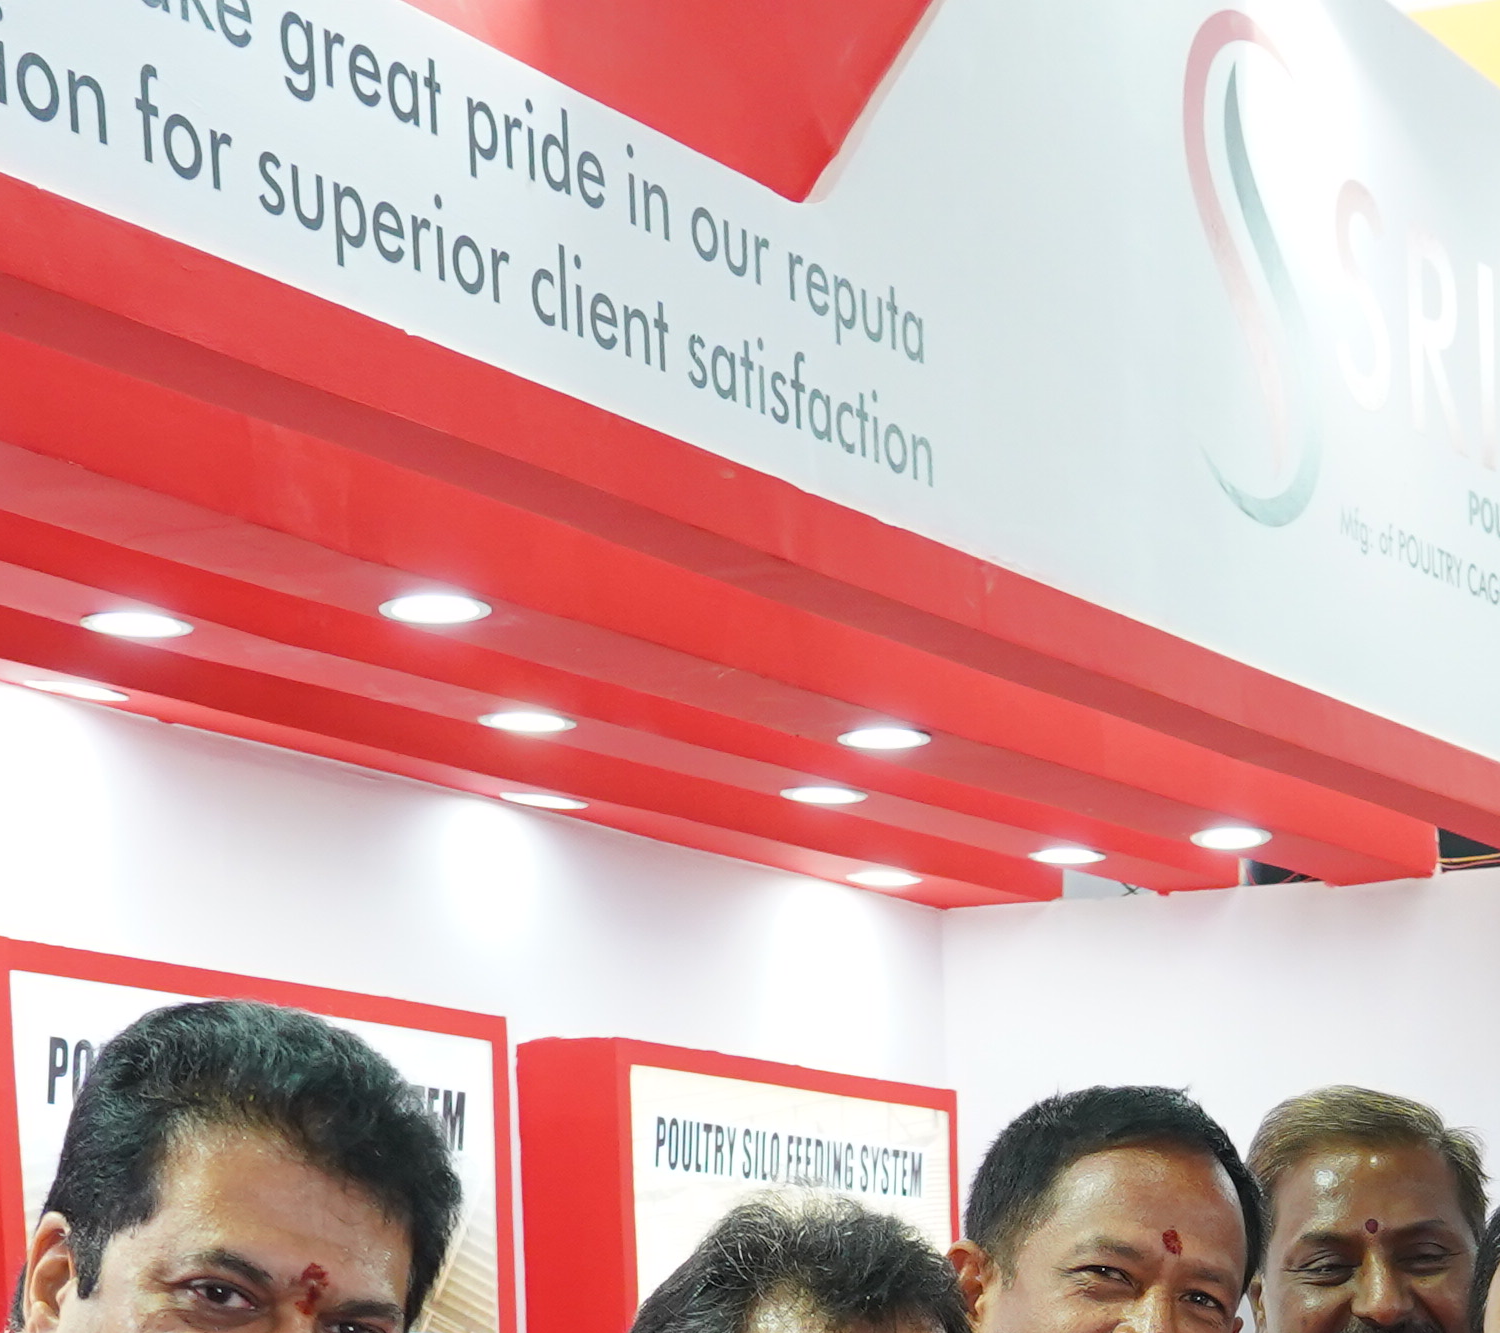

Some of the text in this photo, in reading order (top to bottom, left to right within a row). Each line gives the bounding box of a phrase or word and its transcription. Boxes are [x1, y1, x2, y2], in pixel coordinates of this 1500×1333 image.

[134, 64, 233, 191] for
[260, 150, 510, 304] superior
[531, 243, 669, 373] client
[687, 330, 934, 488] satisfaction
[280, 11, 442, 136] great
[468, 96, 605, 211] pride
[626, 145, 671, 242] in
[691, 204, 770, 287] our
[788, 248, 927, 366] reputa
[1379, 522, 1394, 557] of
[1398, 529, 1463, 588] POULTRY
[655, 1116, 923, 1198] POULTRY SILO FEEDING SYSTEM
